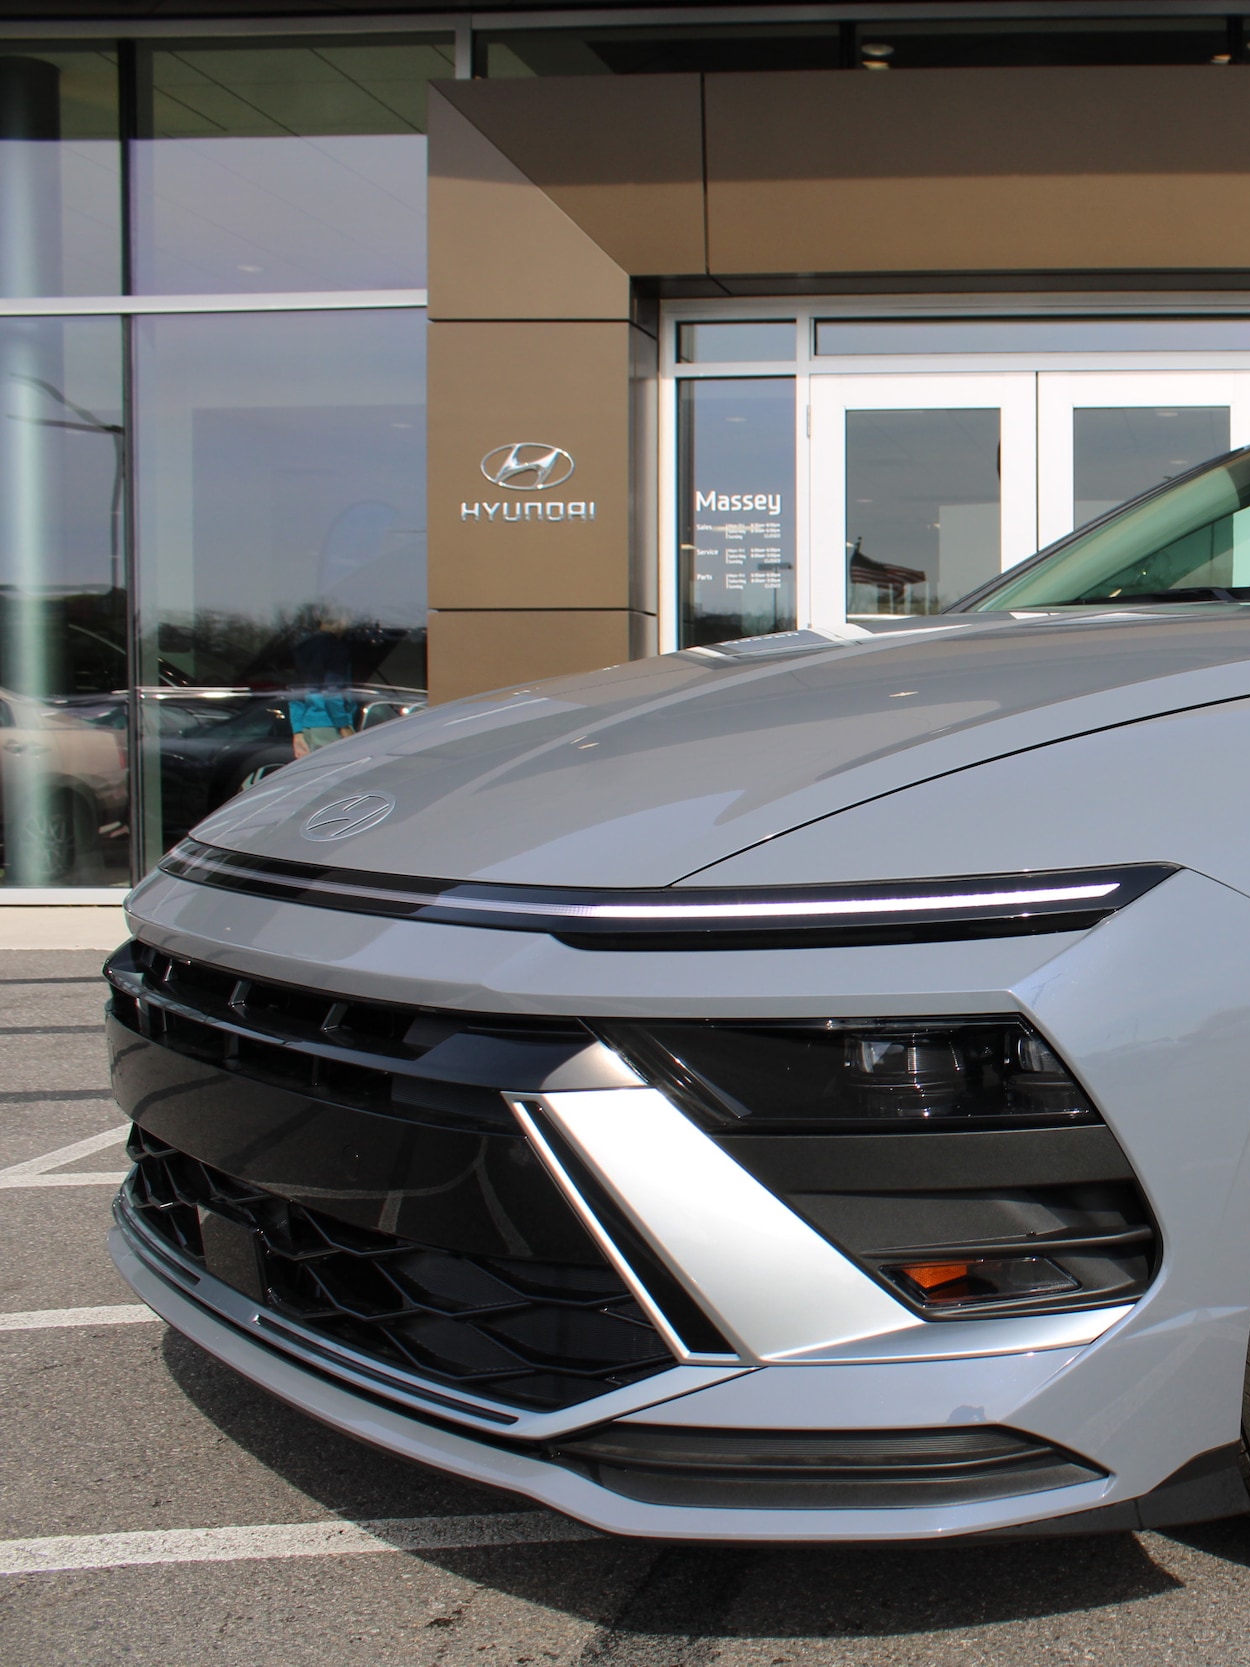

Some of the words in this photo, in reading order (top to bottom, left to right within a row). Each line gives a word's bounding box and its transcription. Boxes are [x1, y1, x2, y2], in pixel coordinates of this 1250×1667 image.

[695, 491, 781, 515] Massey
[460, 501, 596, 522] HYUNDAI
[696, 523, 712, 531] Sales
[696, 548, 719, 556] Service
[696, 573, 713, 581] Parts
